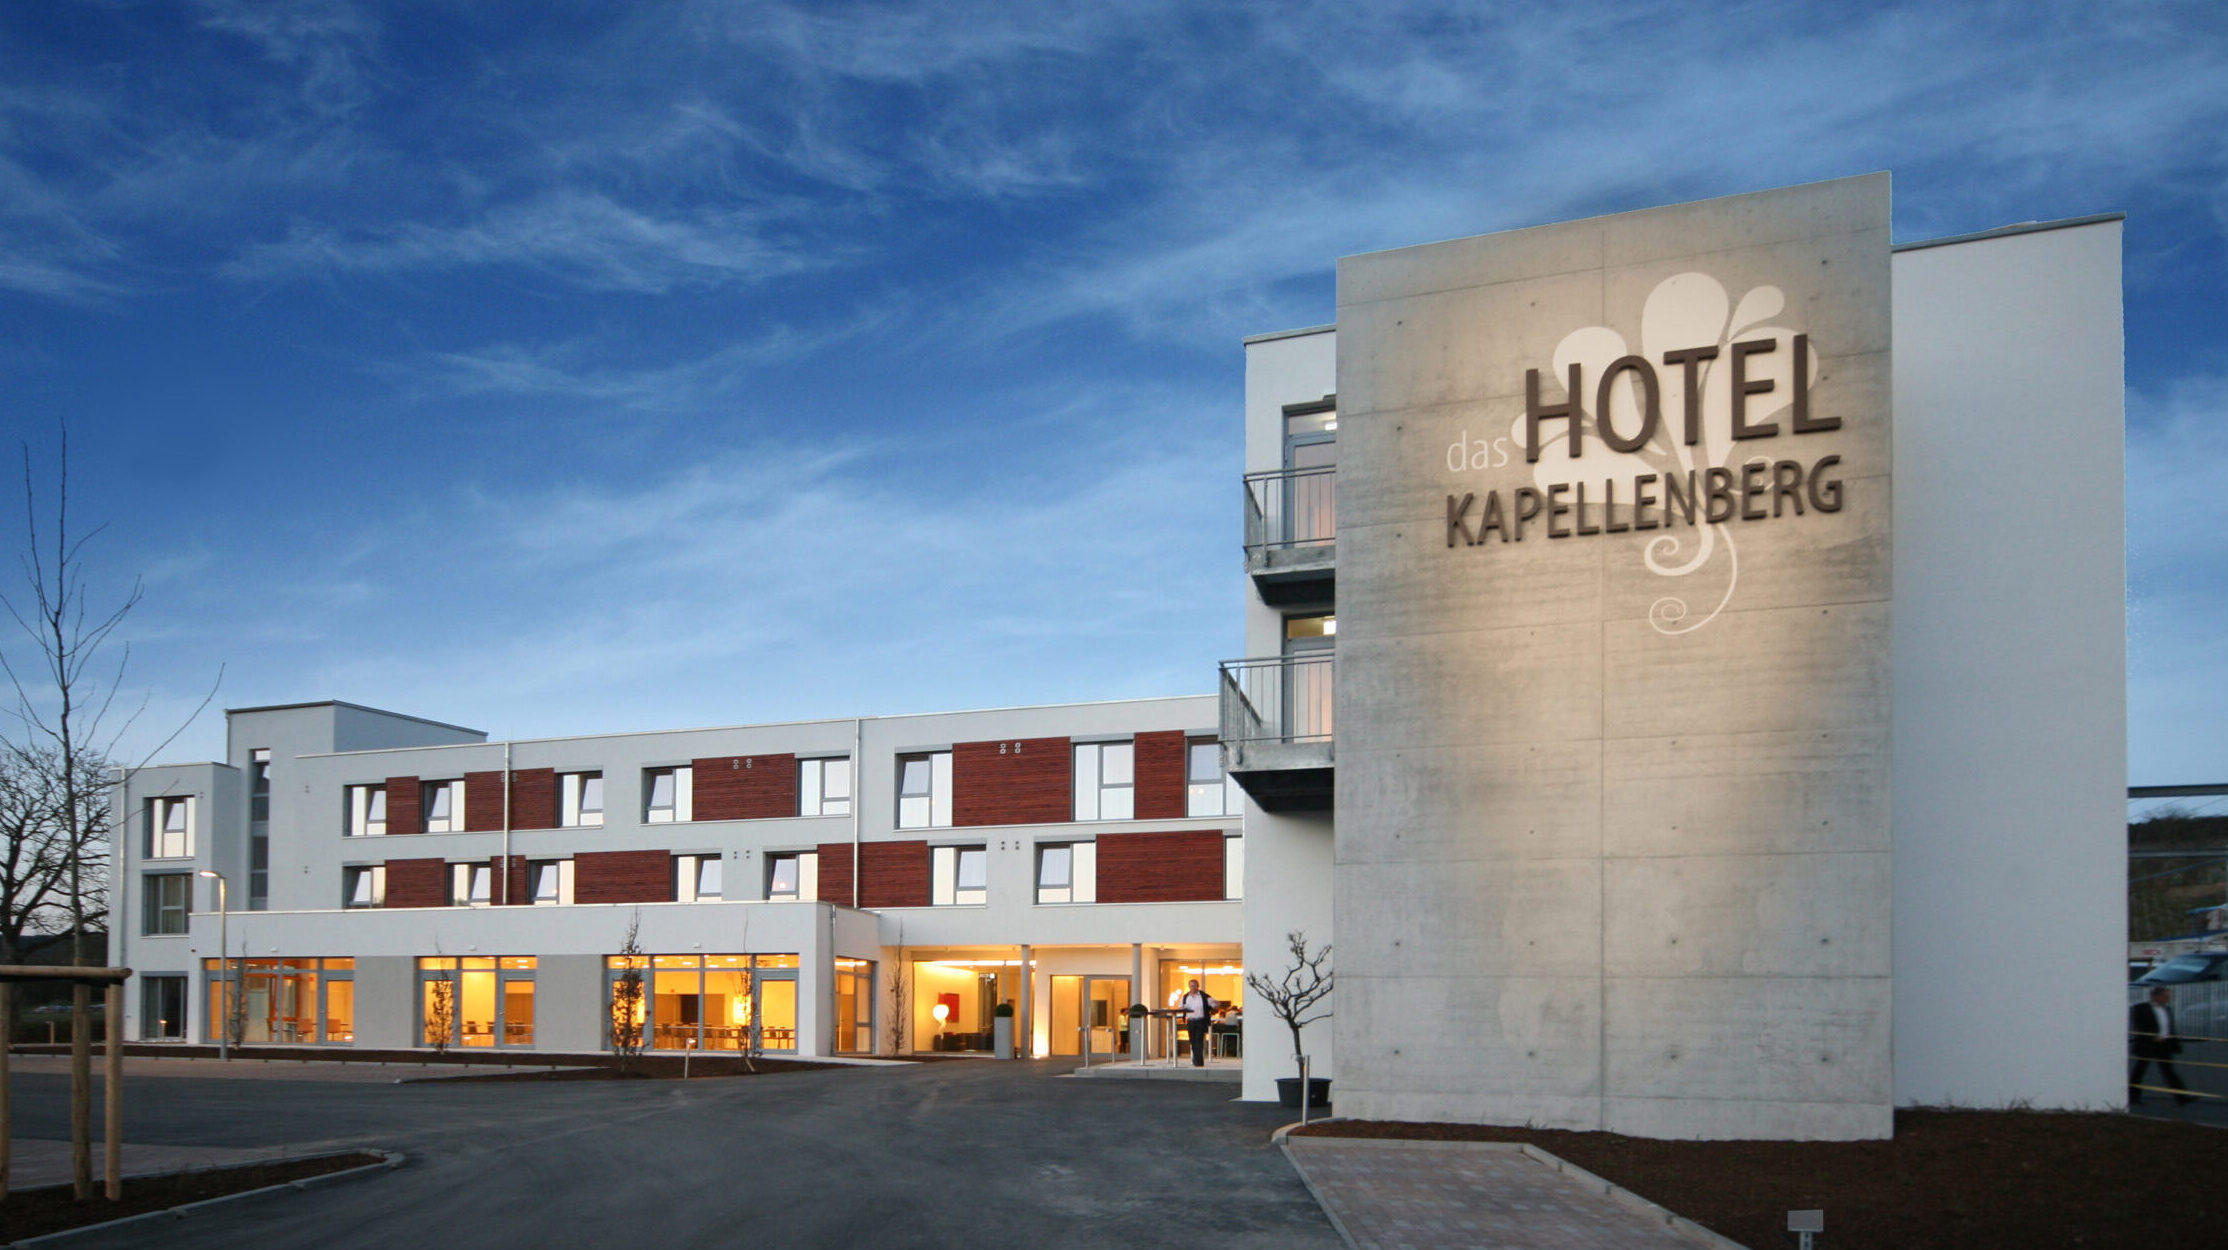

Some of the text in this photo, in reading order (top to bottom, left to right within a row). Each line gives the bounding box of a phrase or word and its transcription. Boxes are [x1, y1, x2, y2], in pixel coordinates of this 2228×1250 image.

[1446, 333, 1842, 472] das HOTEL
[1446, 455, 1843, 548] KAPELLENBERG
